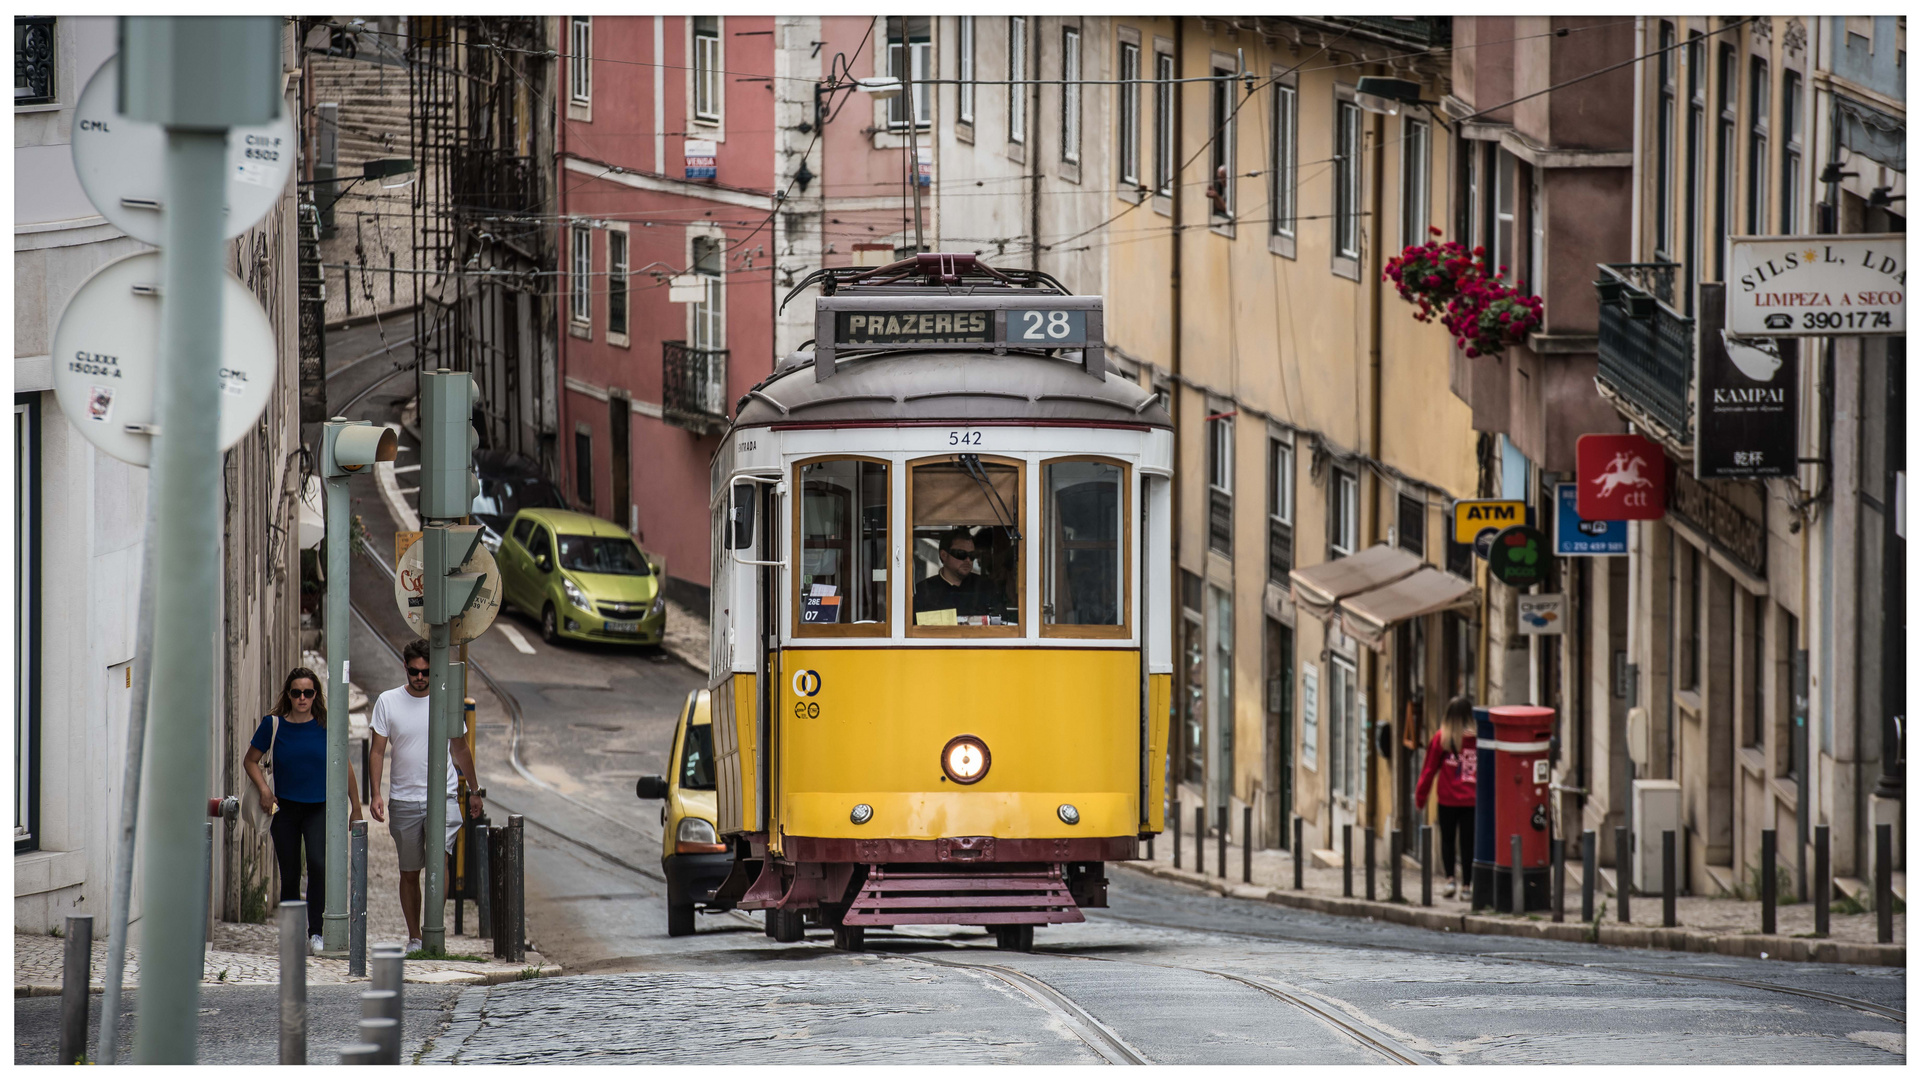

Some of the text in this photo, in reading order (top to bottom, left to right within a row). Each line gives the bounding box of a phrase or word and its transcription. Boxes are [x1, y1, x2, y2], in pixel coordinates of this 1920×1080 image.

[80, 119, 110, 133] CML
[1754, 291, 1903, 307] LIMPEZA A SECO
[850, 312, 986, 335] PRAZERES
[1023, 310, 1071, 340] 28
[218, 368, 249, 382] CML
[1713, 388, 1784, 403] KAMPAI
[949, 431, 982, 446] 542
[1624, 491, 1648, 507] ctt
[1467, 506, 1515, 521] ATM
[807, 598, 820, 606] 28E
[805, 610, 818, 621] 07
